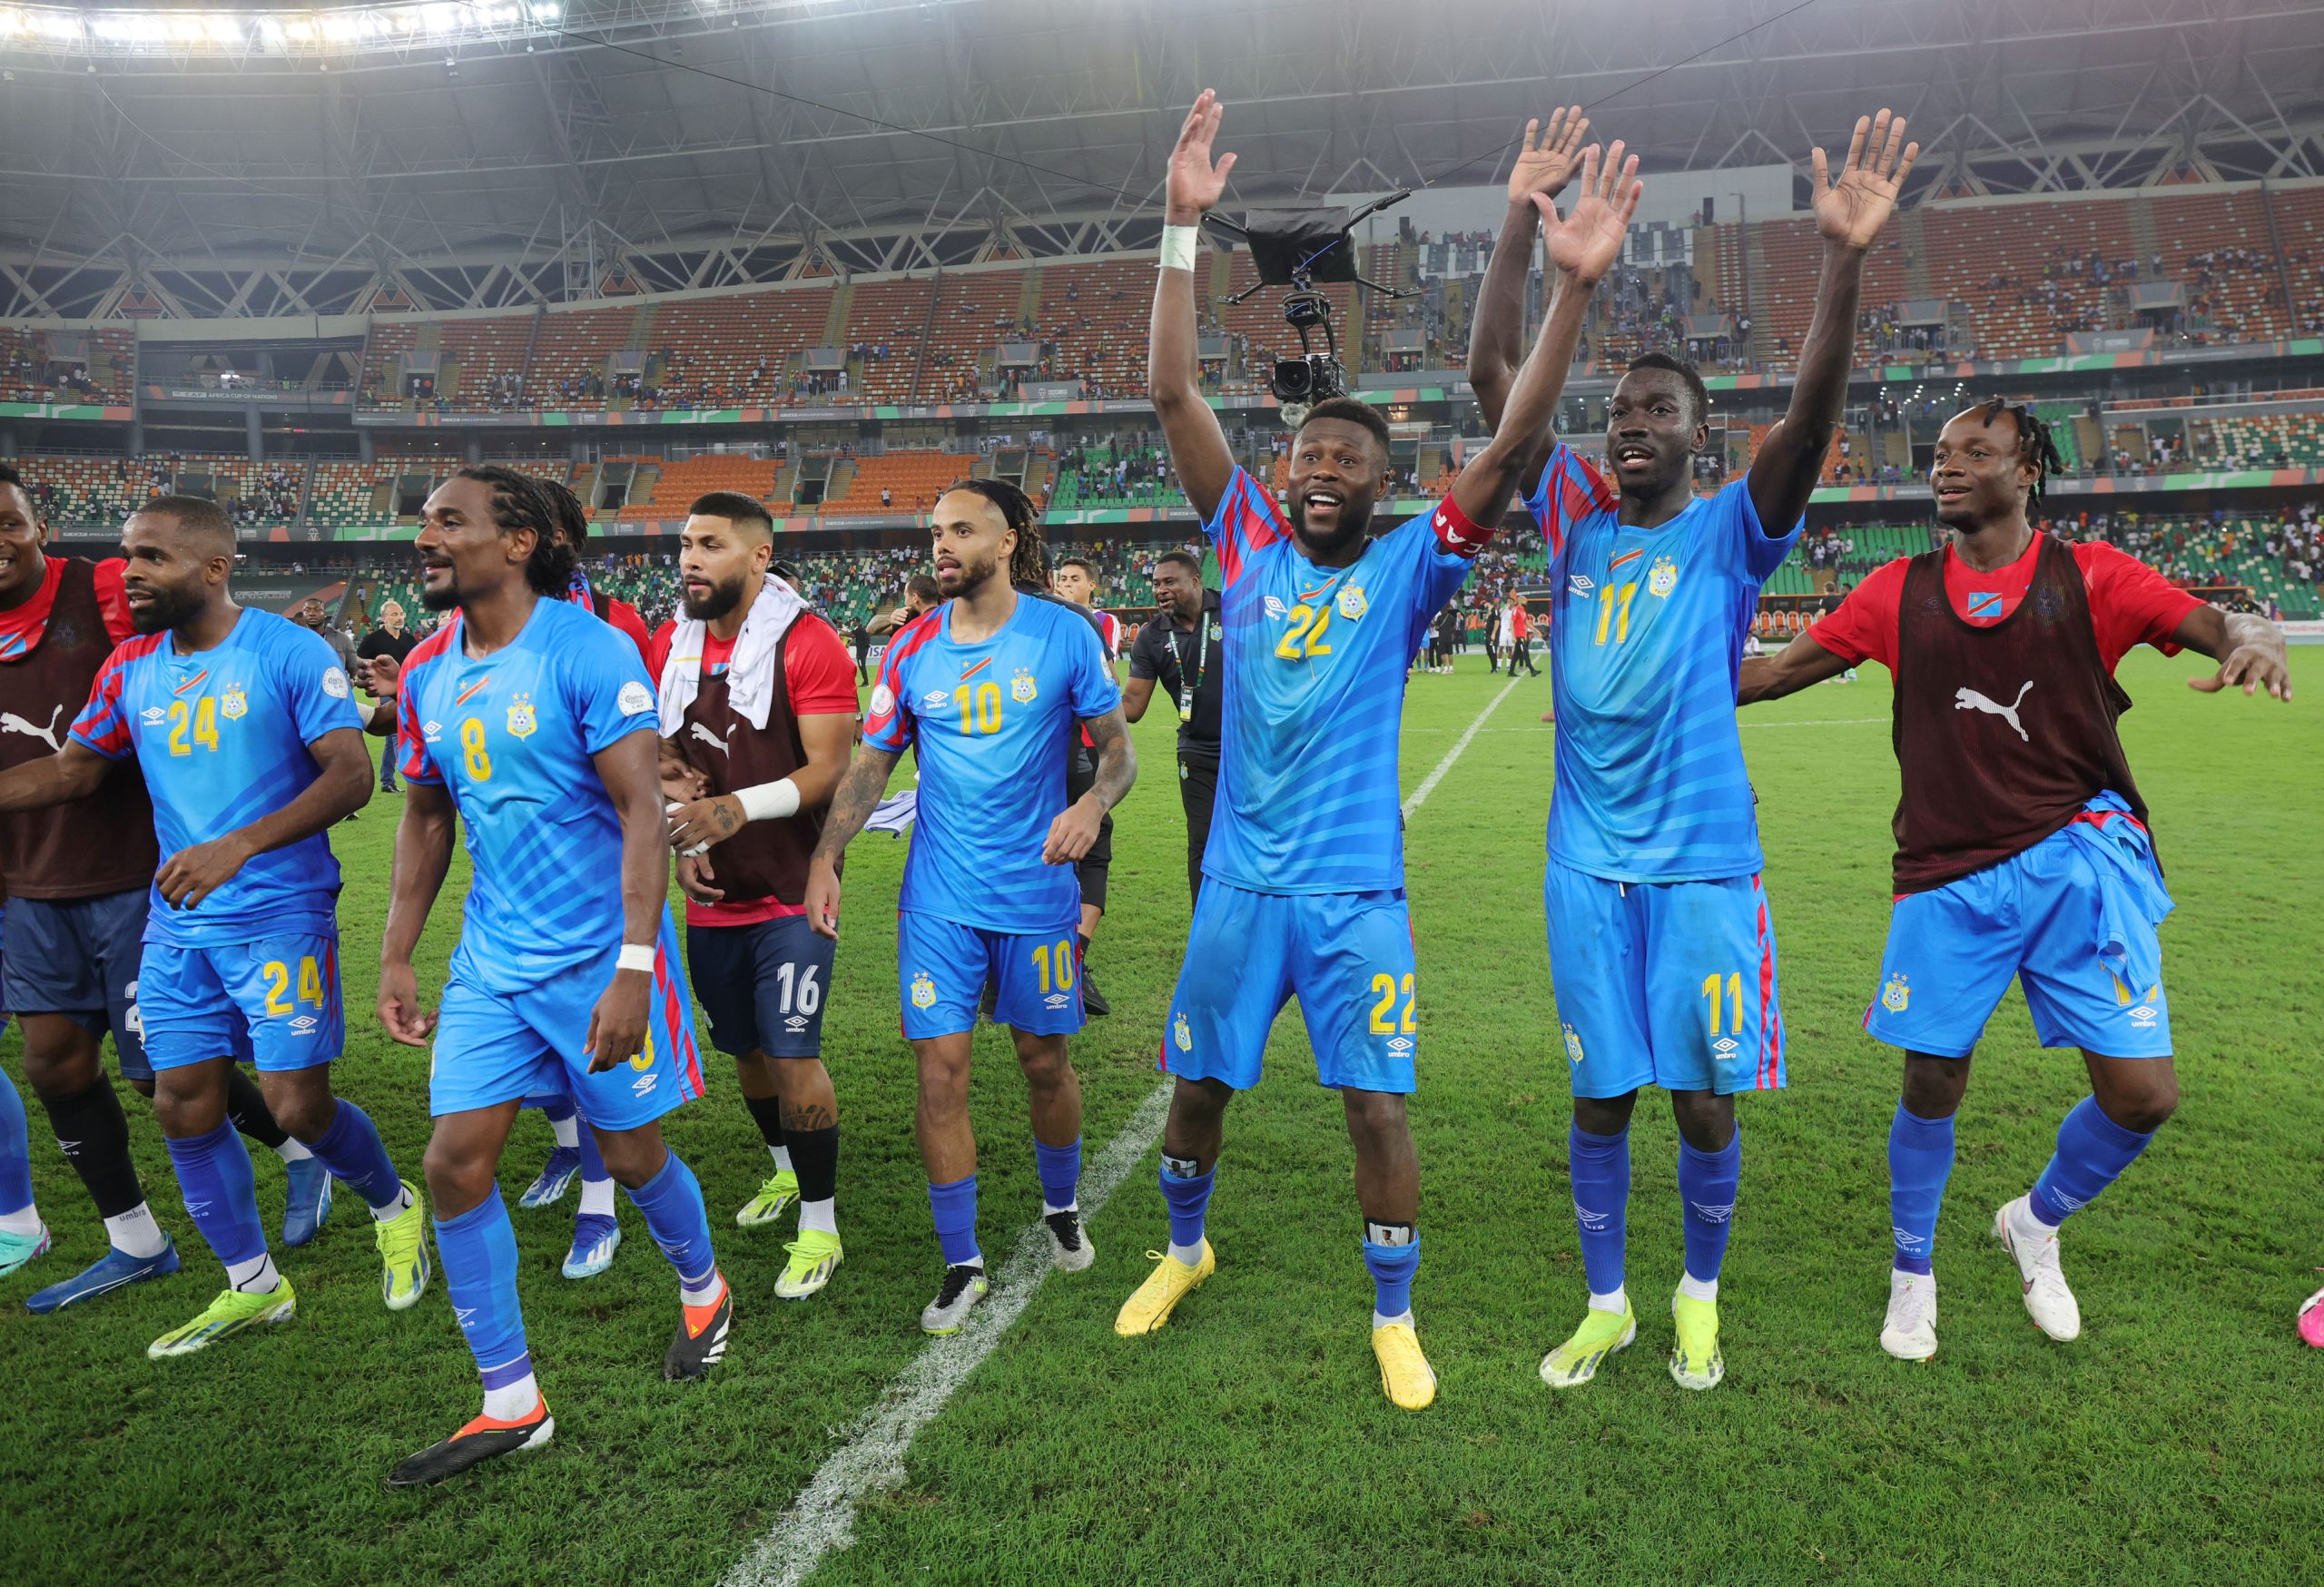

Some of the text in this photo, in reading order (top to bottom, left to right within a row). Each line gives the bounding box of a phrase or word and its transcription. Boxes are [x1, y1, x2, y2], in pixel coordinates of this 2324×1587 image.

[1568, 585, 1590, 598] umbro
[1594, 582, 1637, 646] 11
[1275, 604, 1332, 658] 22
[167, 696, 219, 756] 24
[926, 702, 948, 710] umbro
[952, 682, 1002, 735] 10
[459, 717, 492, 783] 8
[262, 955, 324, 1018] 24
[777, 961, 820, 1016] 16
[1031, 940, 1073, 993] 10
[1369, 972, 1416, 1036] 22
[1702, 971, 1744, 1037] 11
[2131, 1019, 2157, 1028] umbro
[290, 1028, 316, 1036] umbro
[1715, 1051, 1737, 1060] umbro
[635, 1082, 657, 1099] umbro
[119, 1208, 146, 1222] umbro
[1583, 1222, 1605, 1230] bro
[1896, 1242, 1921, 1253] mbro
